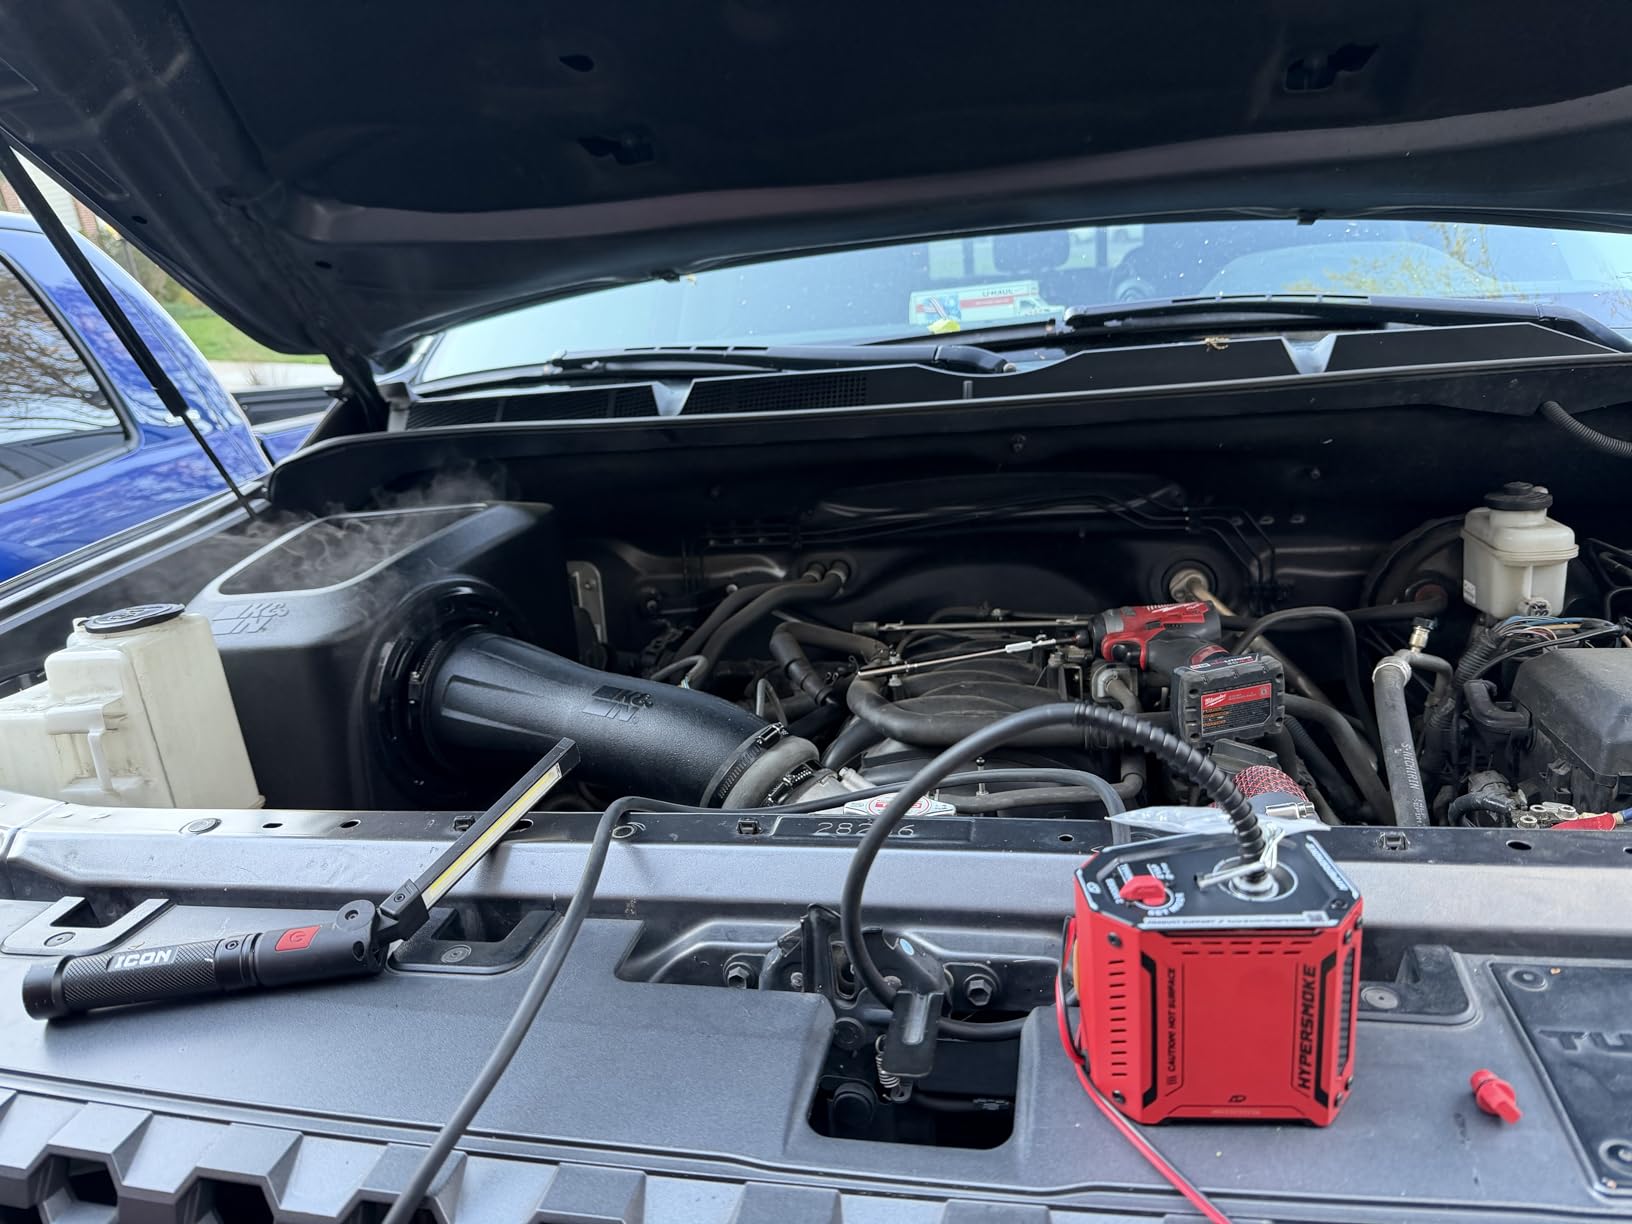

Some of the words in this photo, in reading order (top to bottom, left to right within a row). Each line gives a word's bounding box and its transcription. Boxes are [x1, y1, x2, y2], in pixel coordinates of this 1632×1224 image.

[814, 821, 916, 838] 2826
[114, 949, 173, 969] ICON
[1168, 967, 1176, 1009] SURFACE
[1168, 1009, 1176, 1029] HOT
[1298, 964, 1316, 1089] HYPERSMOKE
